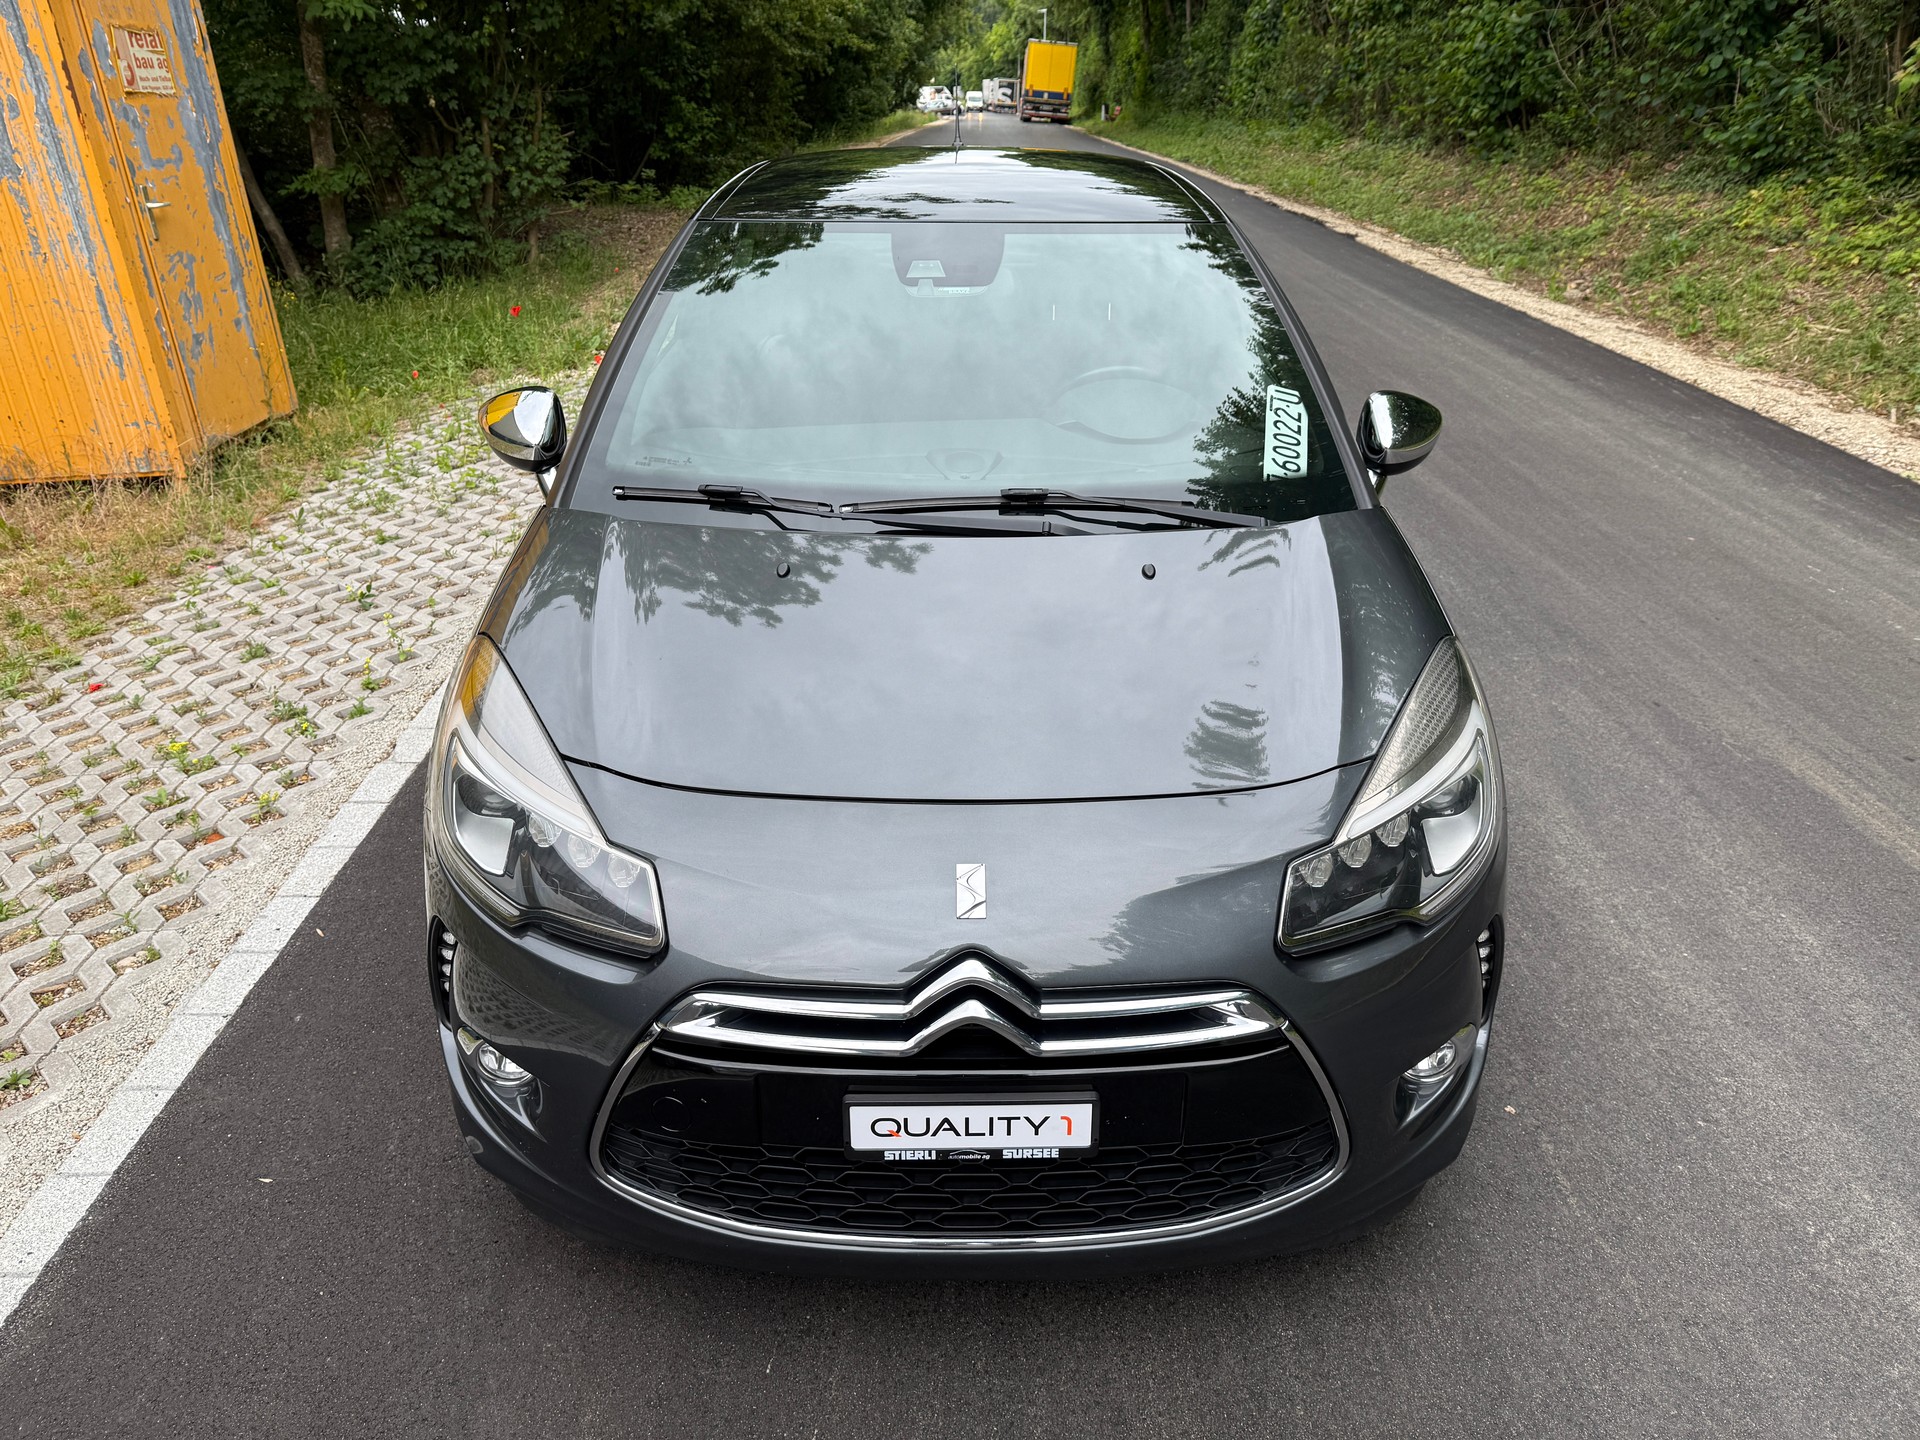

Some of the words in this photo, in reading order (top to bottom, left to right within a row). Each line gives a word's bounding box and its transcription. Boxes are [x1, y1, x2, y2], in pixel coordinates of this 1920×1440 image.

[133, 53, 155, 69] bau
[157, 57, 169, 73] ag
[870, 1116, 1051, 1138] QUALITY
[1060, 1115, 1073, 1136] 1
[884, 1150, 937, 1161] STIERLI
[1002, 1148, 1060, 1159] SURSEE
